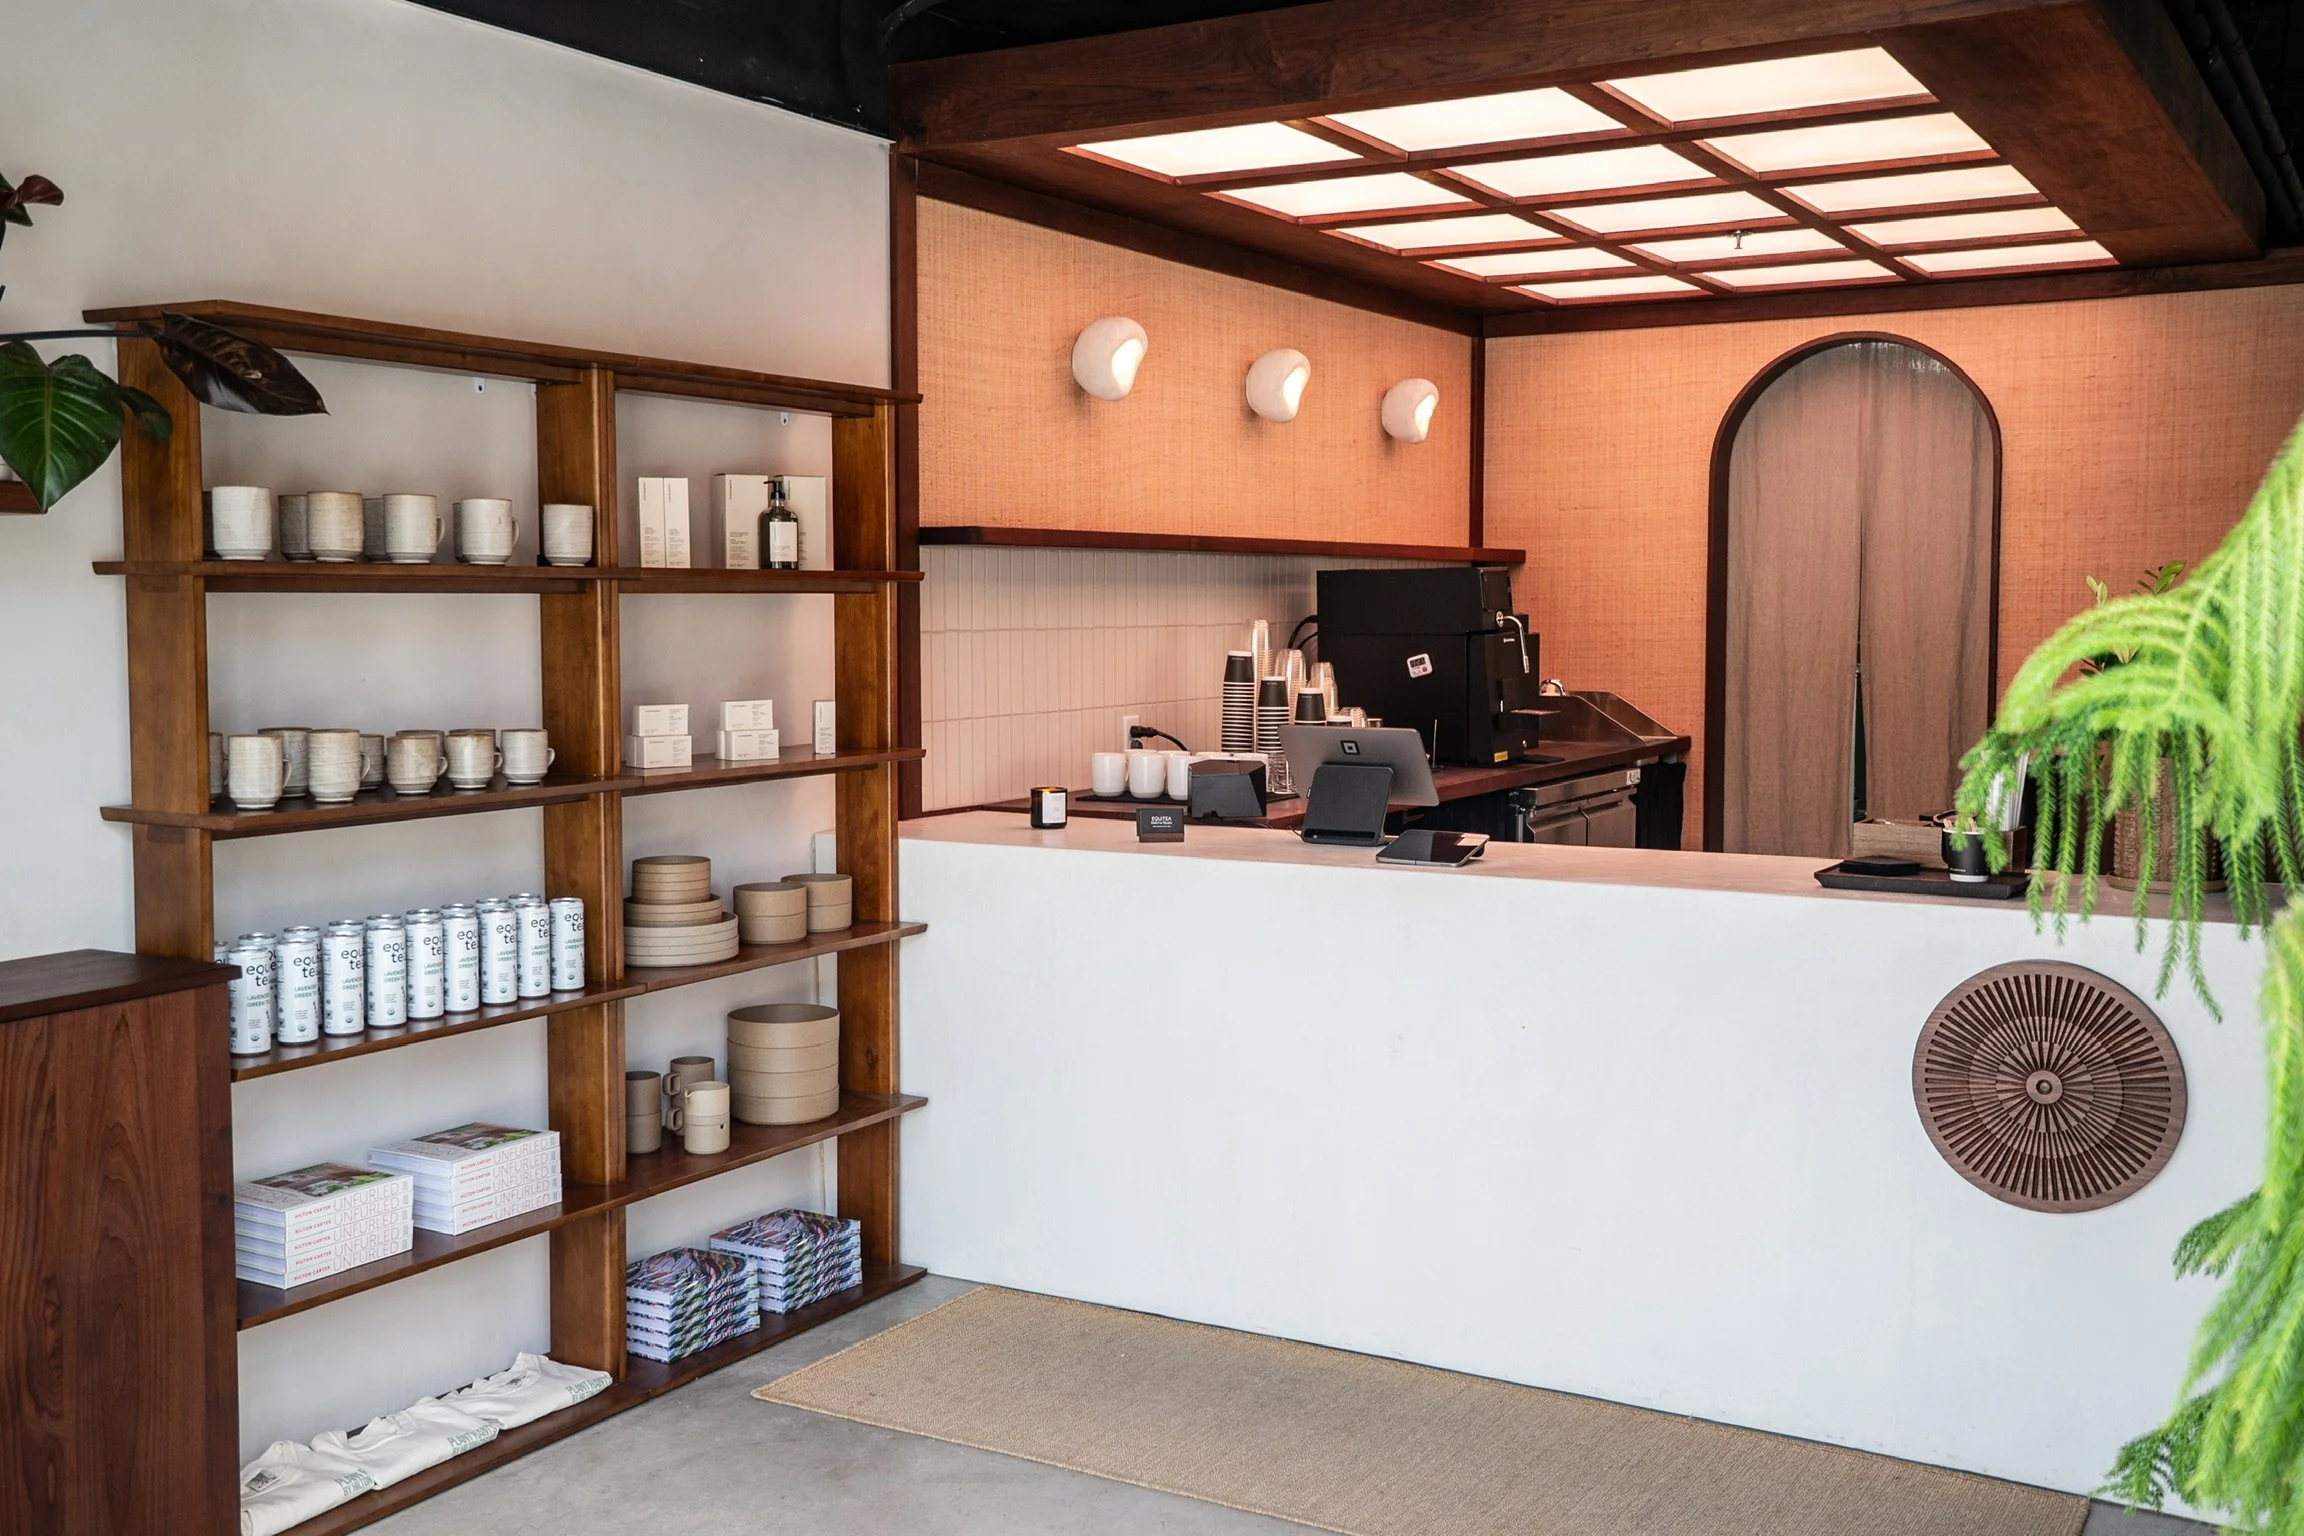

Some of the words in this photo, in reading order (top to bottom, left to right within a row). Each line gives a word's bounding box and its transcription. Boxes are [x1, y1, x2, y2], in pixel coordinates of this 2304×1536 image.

[493, 1139, 548, 1164] UNFURLED
[493, 1152, 548, 1178] UNFURLED
[493, 1166, 549, 1191] UNFURLED
[313, 1205, 331, 1214] CARTER
[334, 1183, 399, 1210] UNFURLED
[495, 1180, 550, 1206] UNFURLED
[495, 1193, 550, 1219] UNFURLED
[314, 1220, 331, 1228] CARTER
[334, 1196, 399, 1225] UNFURLED
[313, 1236, 330, 1244] CARTER
[333, 1212, 399, 1241] UNFURLED
[314, 1251, 332, 1259] CARTER
[334, 1228, 399, 1256] UNFURLED
[313, 1266, 330, 1274] CARTER
[333, 1242, 399, 1271] UNFURLED
